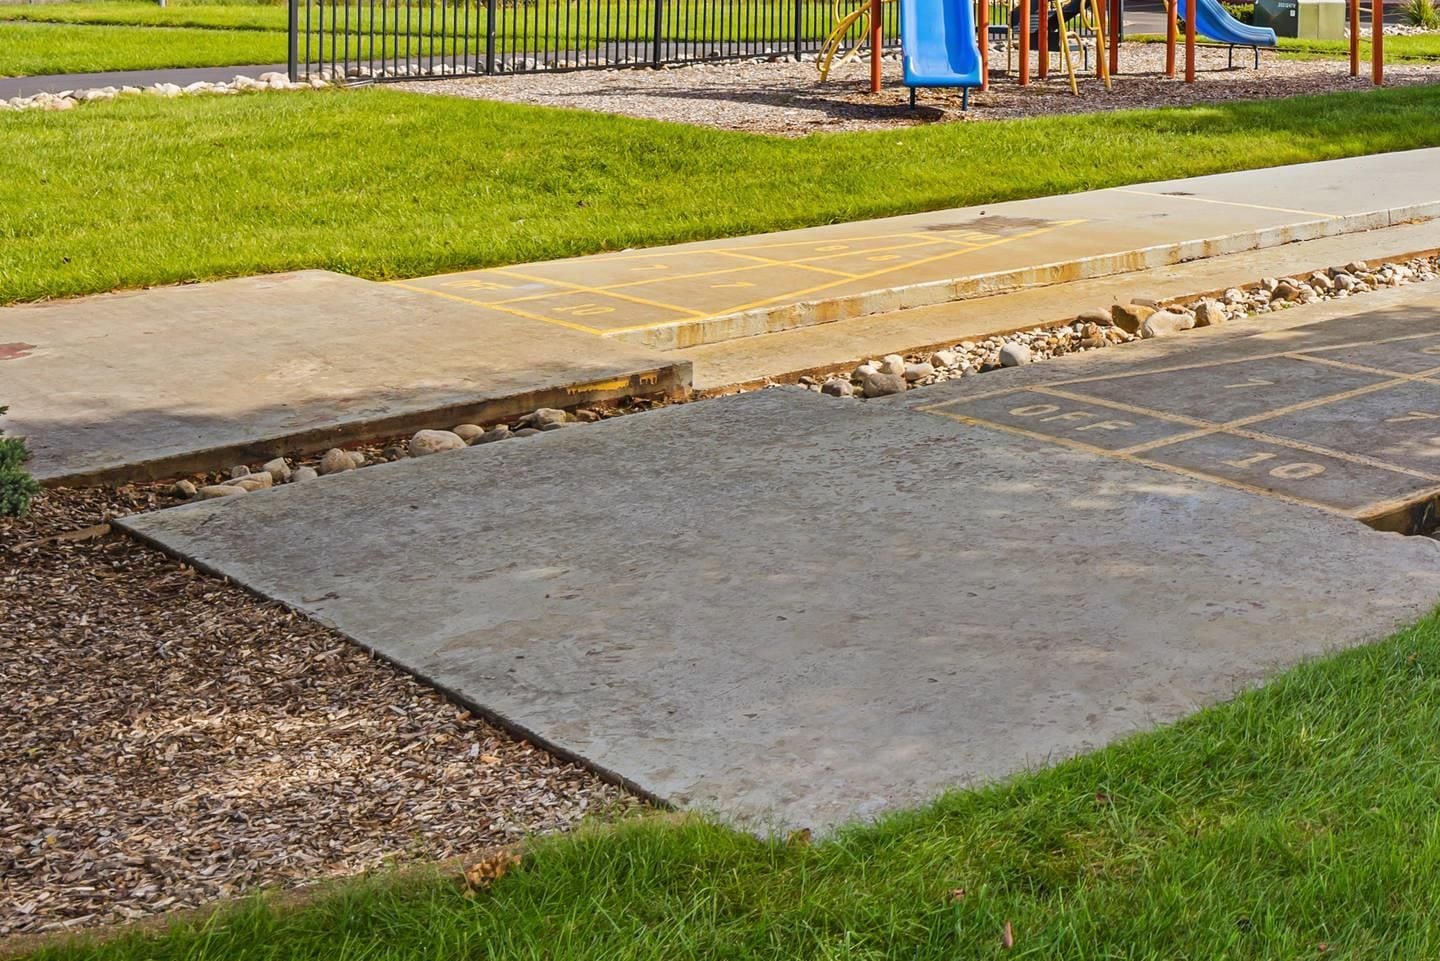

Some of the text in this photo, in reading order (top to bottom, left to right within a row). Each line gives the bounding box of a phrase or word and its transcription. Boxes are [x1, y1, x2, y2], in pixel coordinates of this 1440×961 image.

[551, 303, 616, 317] 10
[1008, 403, 1137, 432] OFF
[1219, 451, 1327, 480] 10
